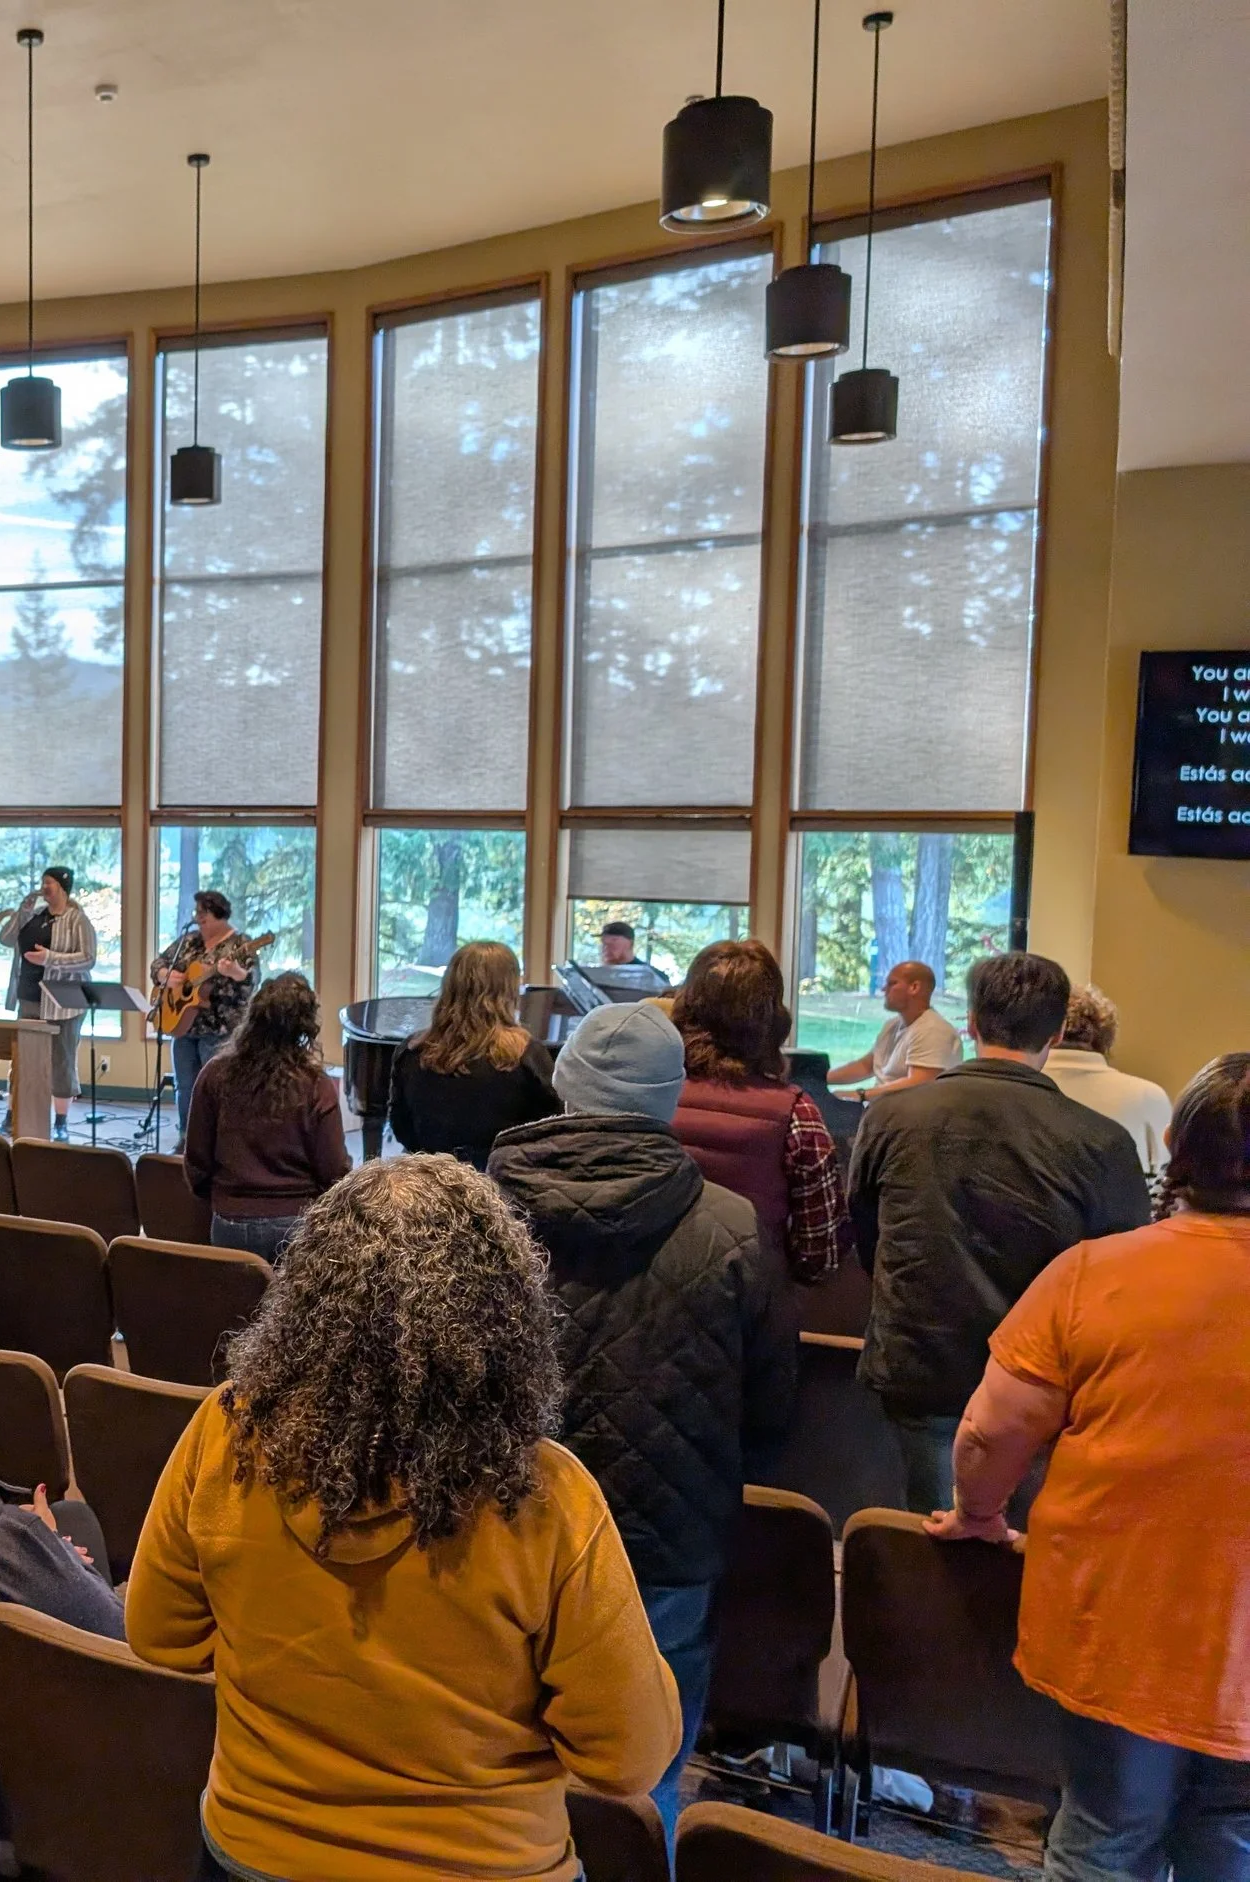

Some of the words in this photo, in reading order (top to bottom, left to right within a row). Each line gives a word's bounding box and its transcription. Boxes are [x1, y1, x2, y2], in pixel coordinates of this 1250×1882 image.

[1192, 665, 1229, 681] You
[1223, 686, 1229, 702] I
[1196, 707, 1233, 723] You
[1220, 728, 1226, 744] I
[1180, 764, 1226, 782] Estás
[1177, 805, 1223, 823] Estás
